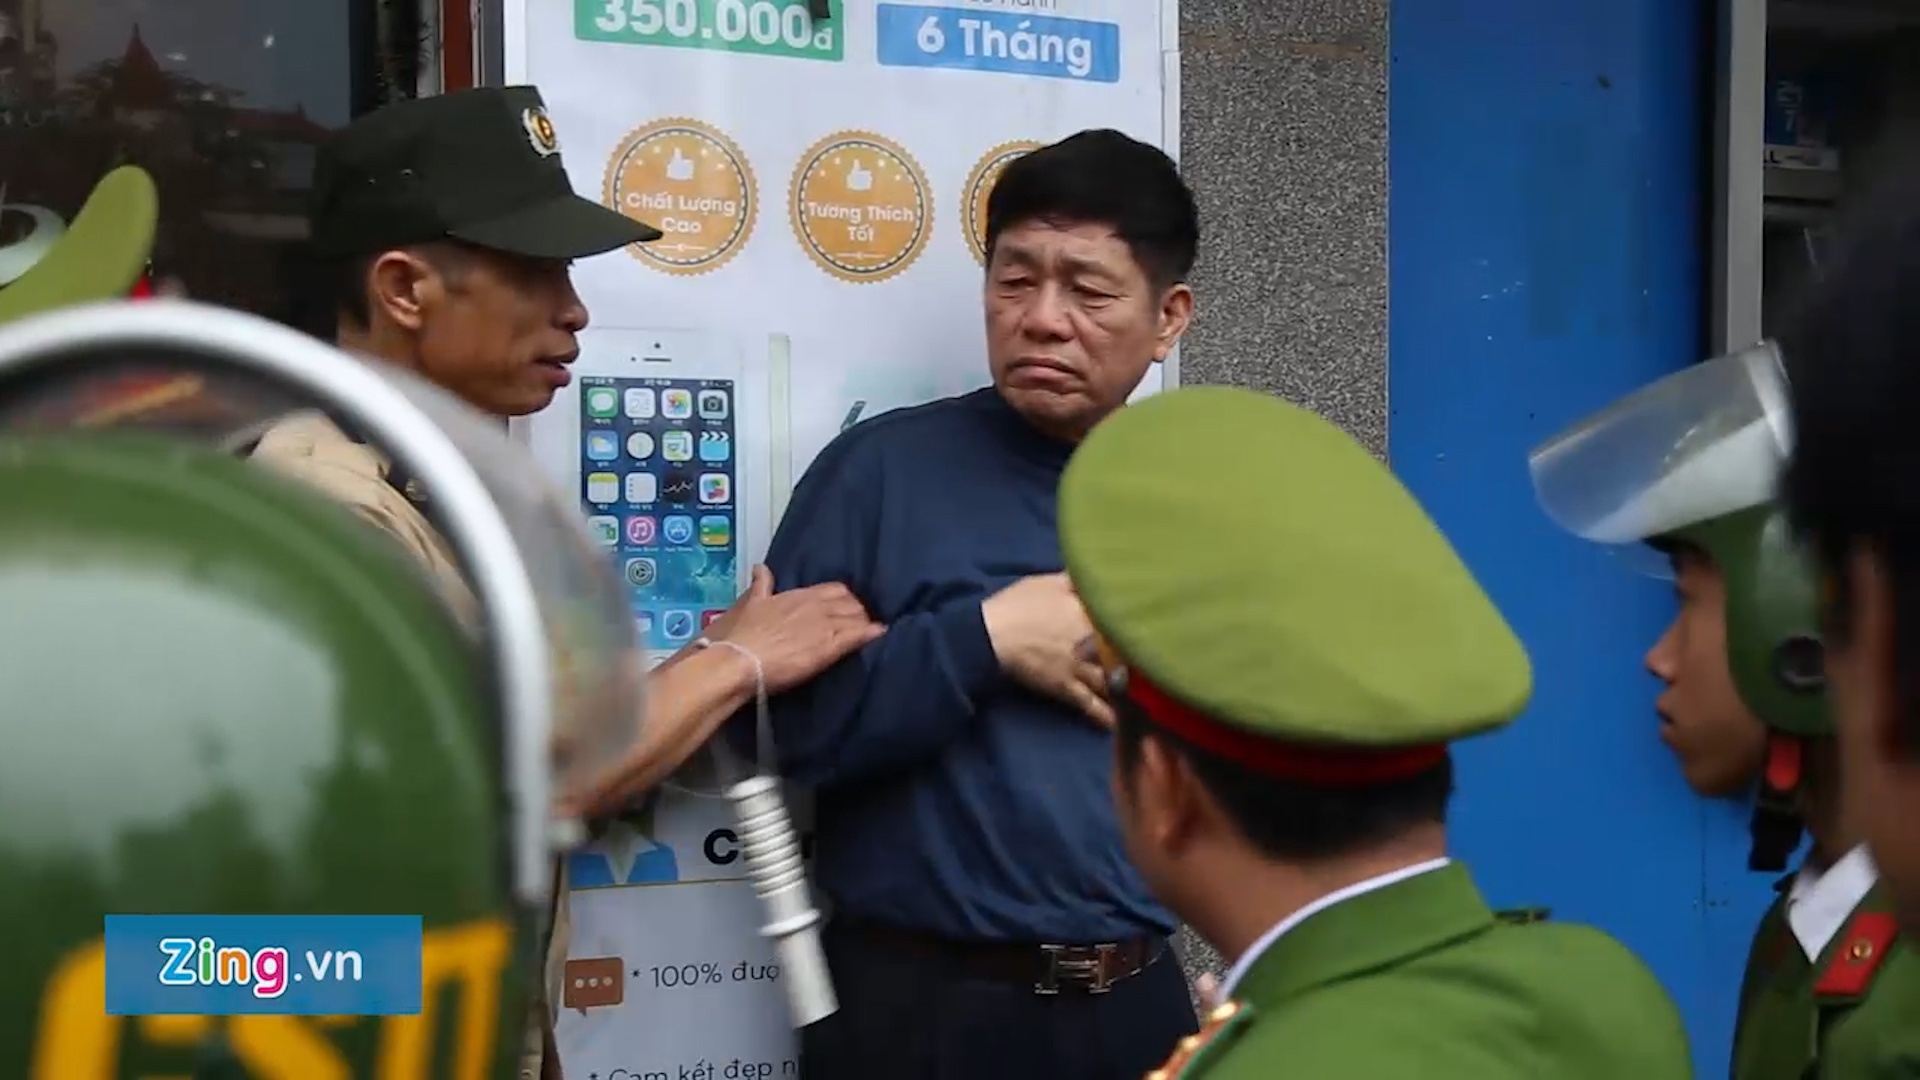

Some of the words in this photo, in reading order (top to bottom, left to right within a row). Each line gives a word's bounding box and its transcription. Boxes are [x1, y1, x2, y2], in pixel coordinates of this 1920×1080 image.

[917, 16, 945, 53] 6
[958, 19, 1092, 77] Tháng
[626, 191, 673, 209] Chất
[679, 195, 736, 217] Lượng
[808, 201, 861, 224] Tương
[867, 205, 914, 221] Thích
[661, 217, 702, 232] Cao
[847, 223, 874, 241] Tốt
[650, 962, 722, 988] 100%
[679, 1058, 714, 1080] kết
[723, 1058, 772, 1080] đẹp
